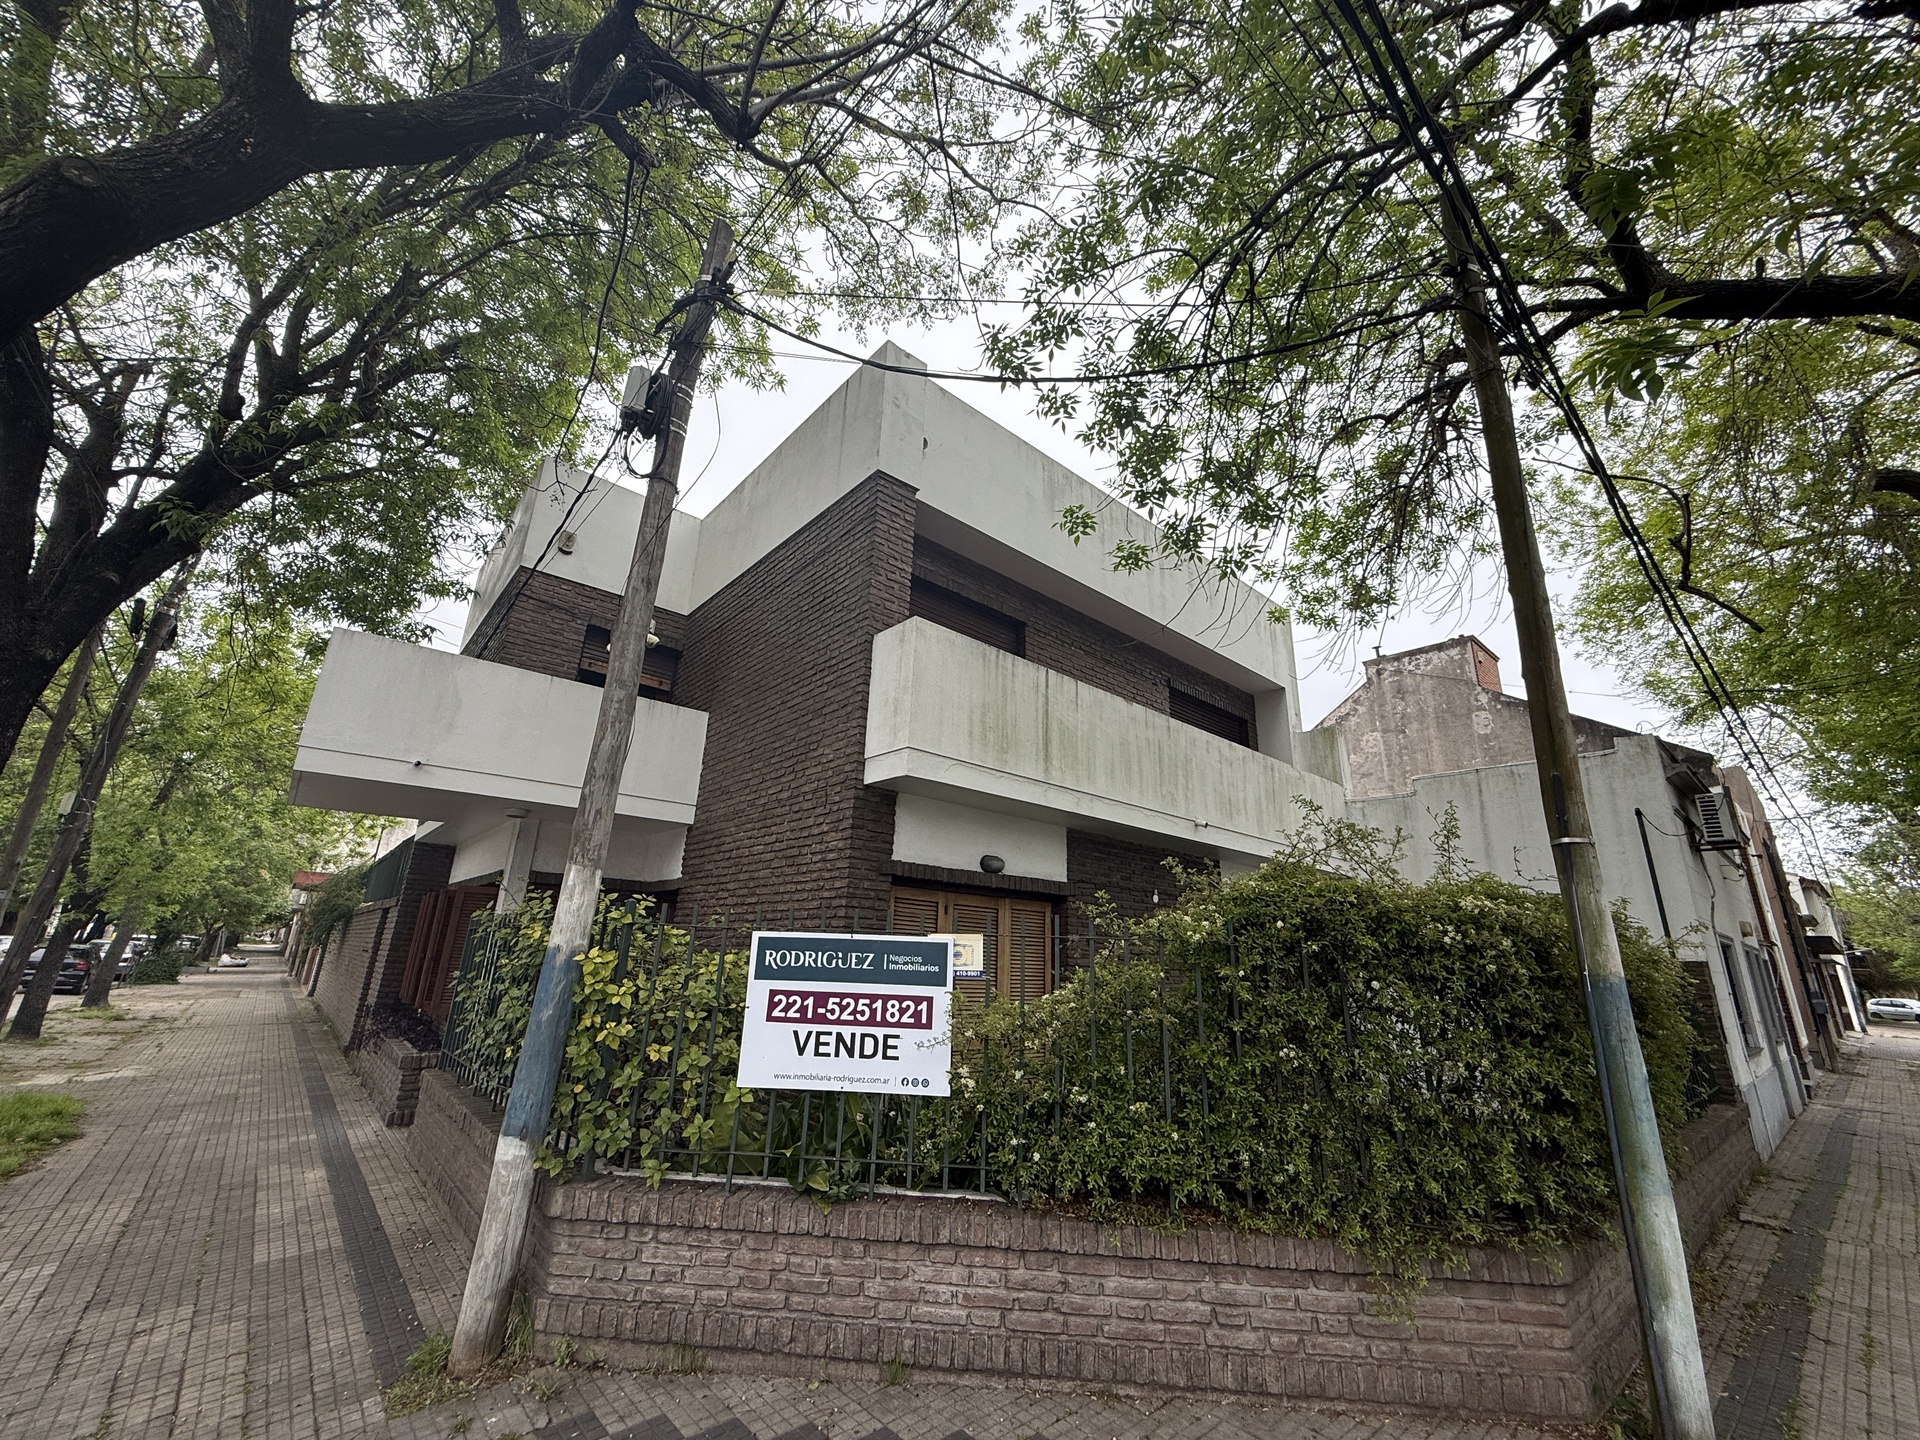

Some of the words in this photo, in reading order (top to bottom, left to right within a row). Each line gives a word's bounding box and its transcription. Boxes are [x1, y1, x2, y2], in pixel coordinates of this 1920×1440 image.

[765, 950, 875, 970] RODRIGUEZ
[889, 954, 923, 964] Negocios
[889, 963, 940, 973] Inmobiliarios
[771, 994, 927, 1024] 221-5251821
[792, 1030, 900, 1061] VENDE
[773, 1072, 890, 1085] www.inmobiliaria-rodriguez.com.ar
